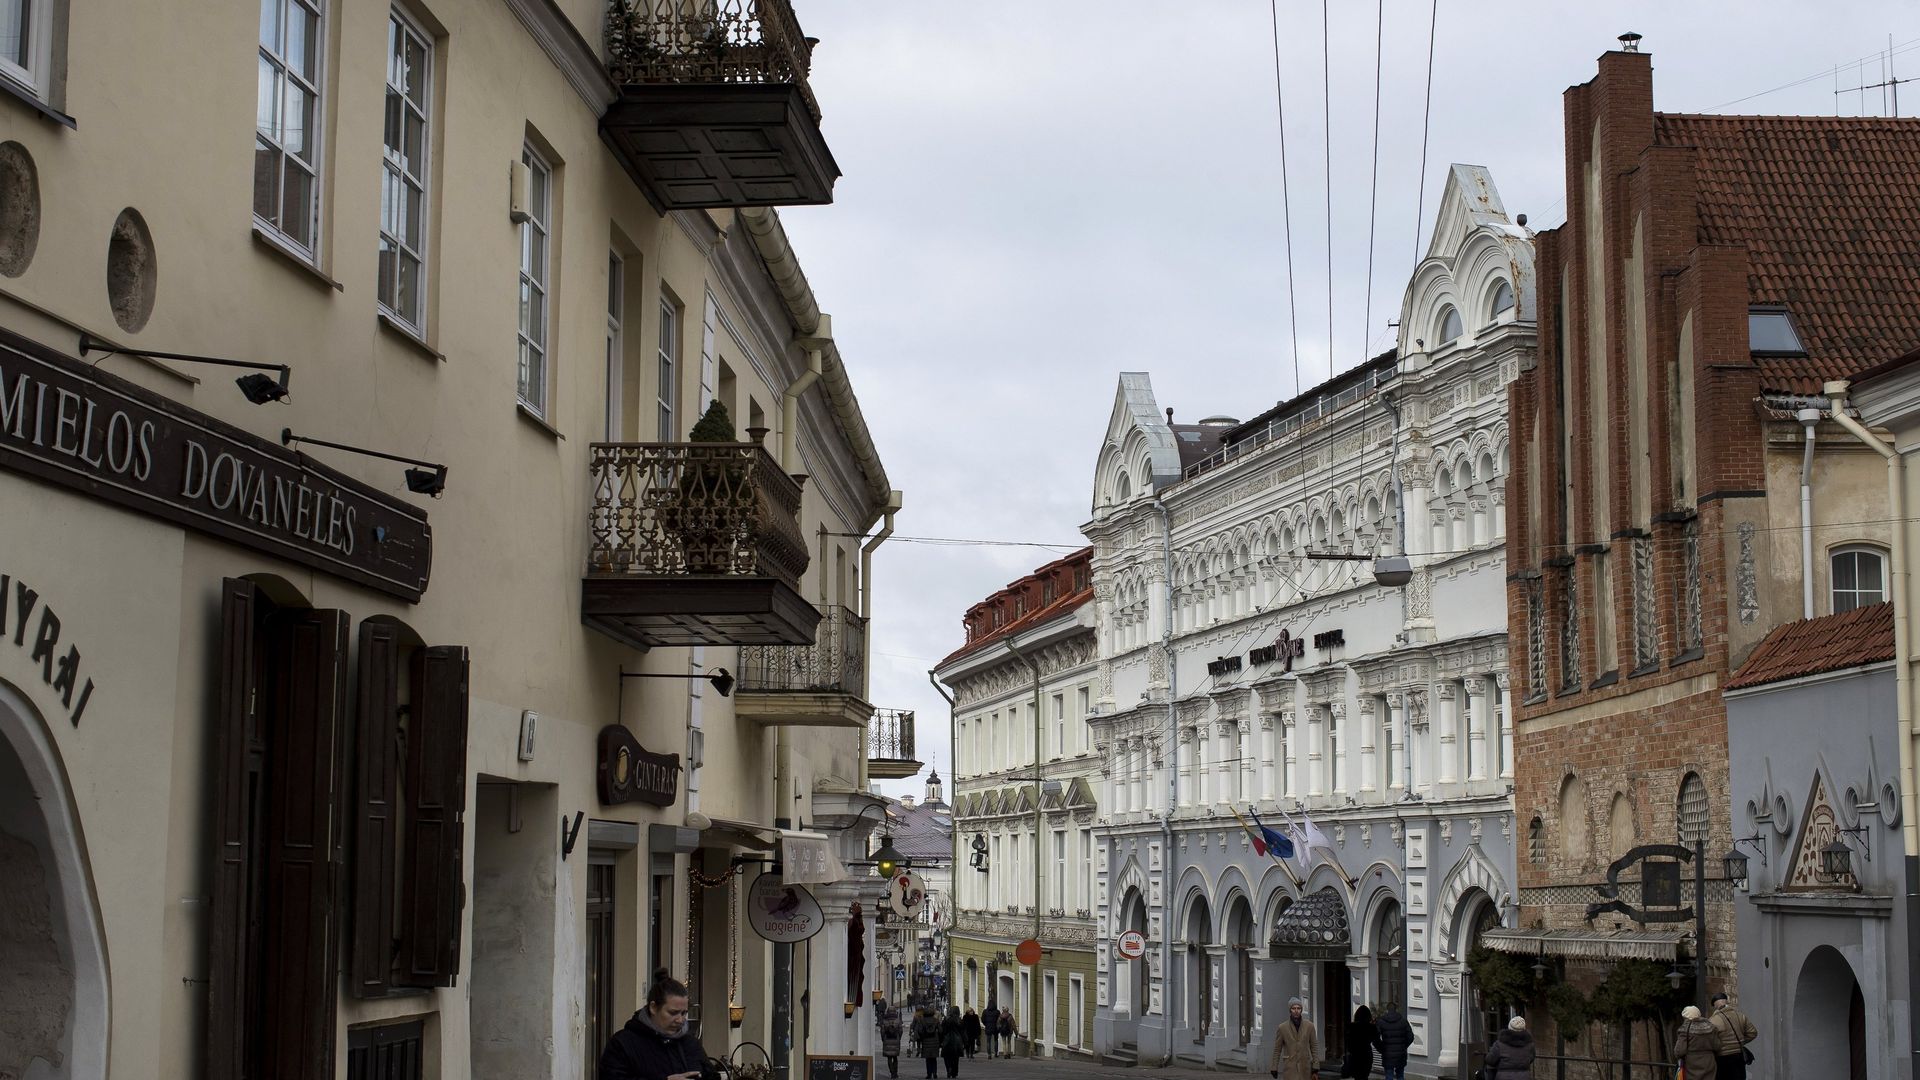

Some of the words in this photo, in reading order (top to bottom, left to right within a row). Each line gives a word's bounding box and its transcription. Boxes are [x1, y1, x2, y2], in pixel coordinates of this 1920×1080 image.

[0, 365, 155, 482] MIELOS
[181, 439, 357, 556] DOVANĖLĖS
[636, 759, 676, 795] GINTARAS
